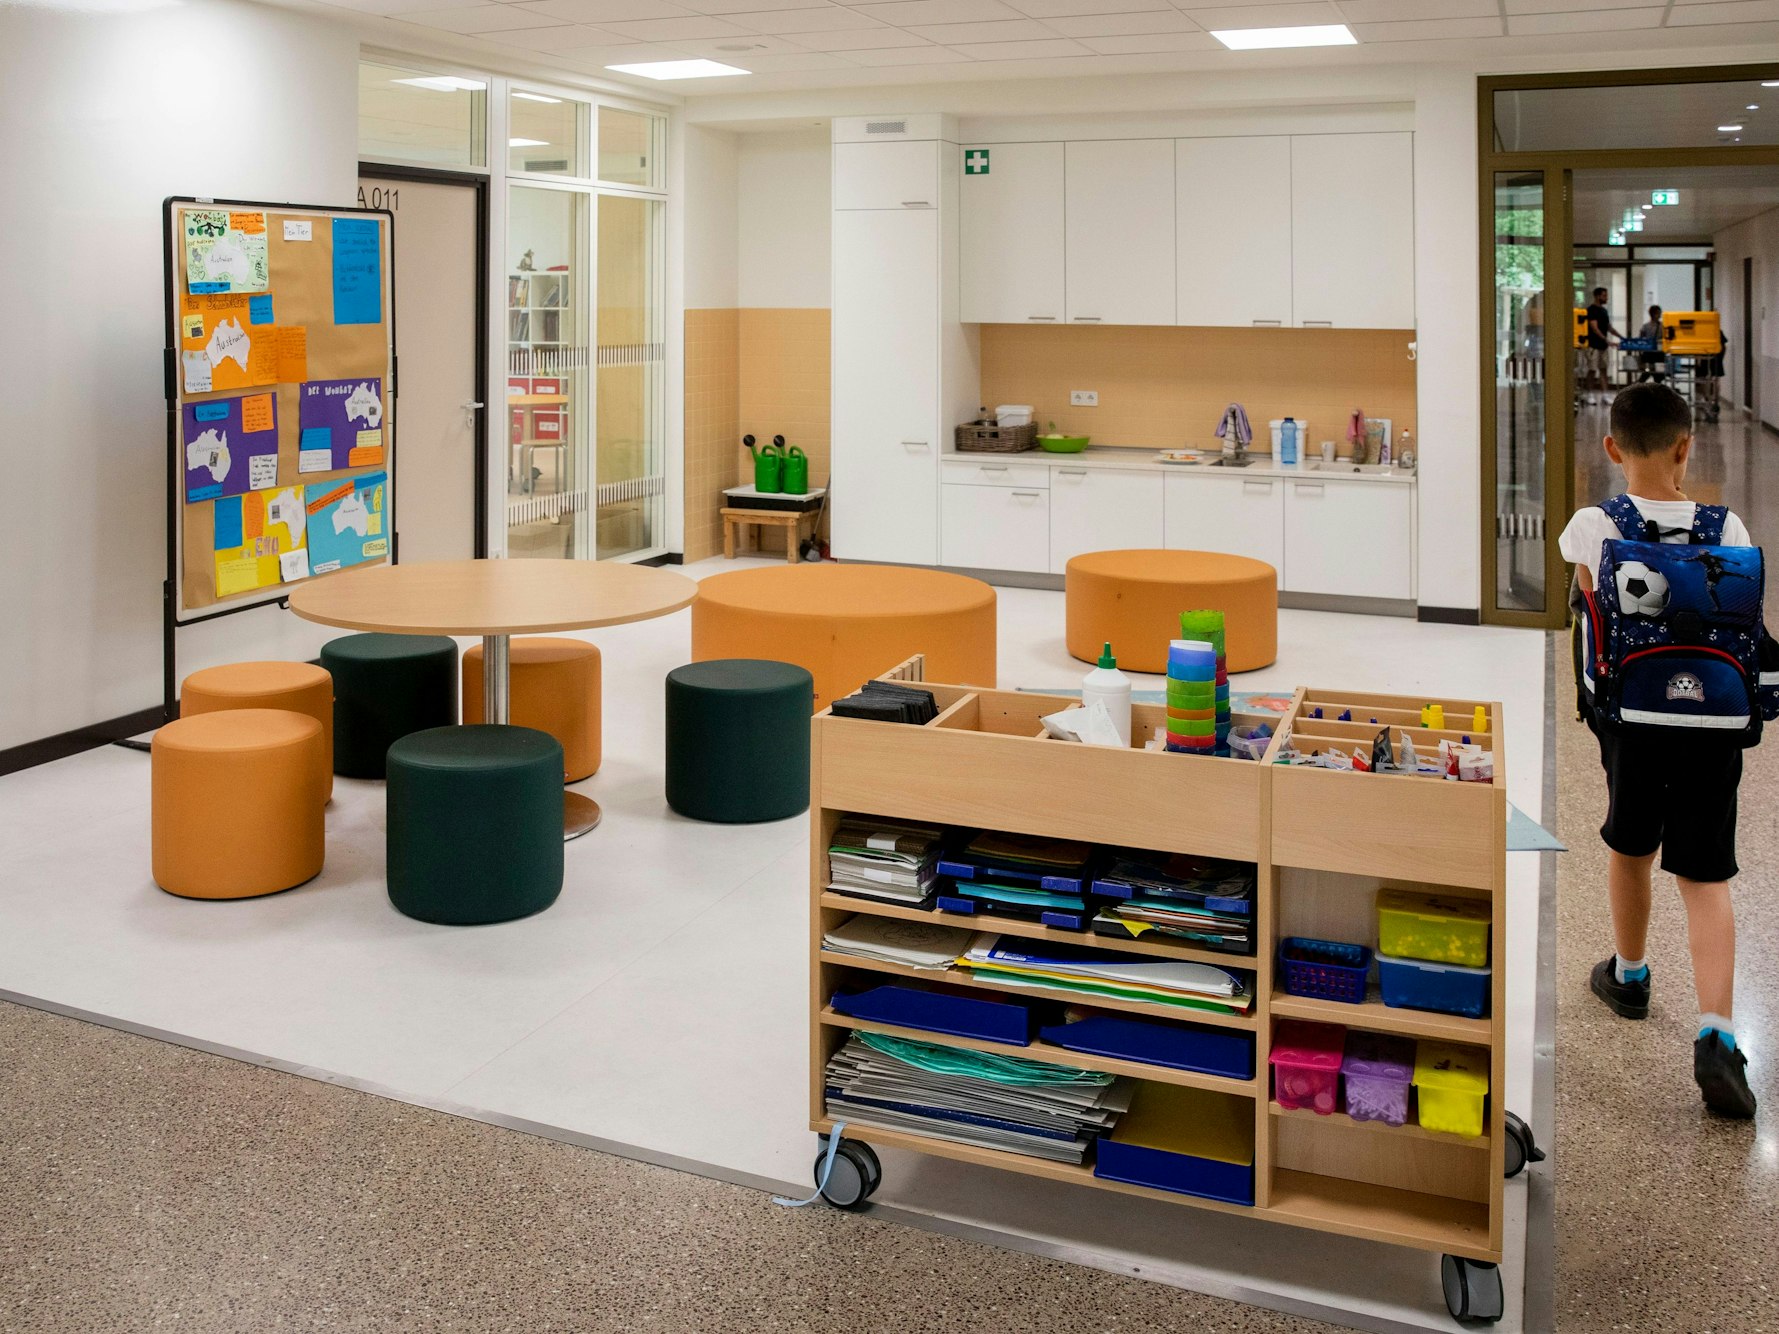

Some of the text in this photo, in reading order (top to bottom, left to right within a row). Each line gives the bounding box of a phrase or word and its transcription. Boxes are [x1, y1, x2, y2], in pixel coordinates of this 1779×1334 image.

[357, 186, 398, 211] A 011
[255, 536, 280, 557] EMU
